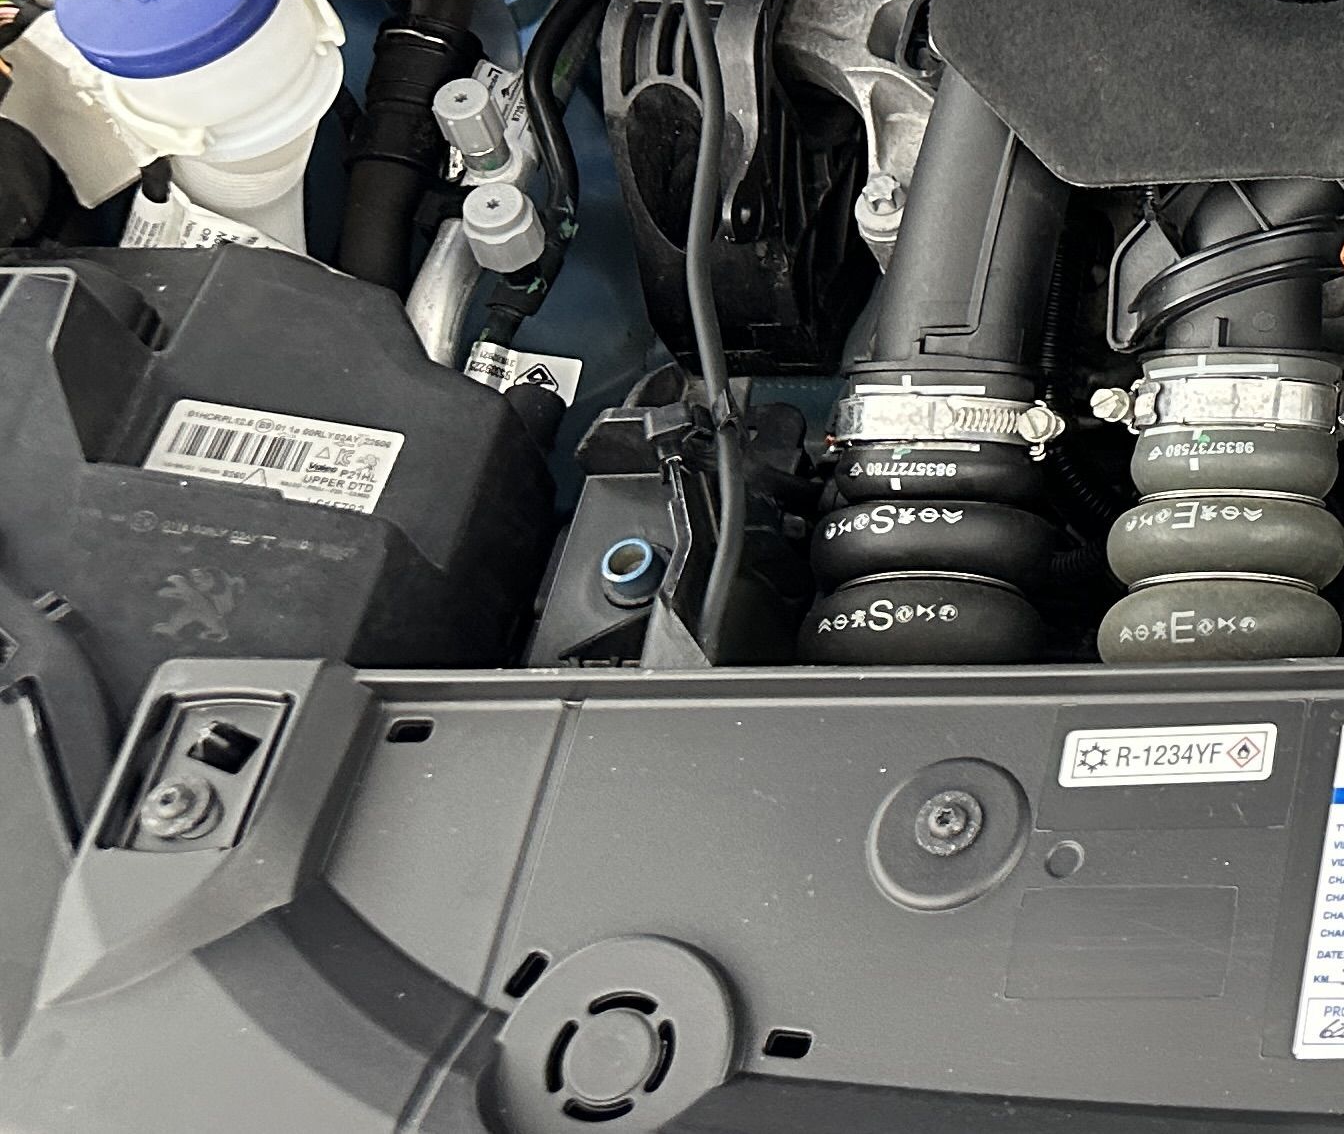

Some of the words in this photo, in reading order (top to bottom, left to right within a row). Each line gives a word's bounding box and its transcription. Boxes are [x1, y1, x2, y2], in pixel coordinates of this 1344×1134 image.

[303, 474, 344, 488] UPPER
[348, 480, 375, 493] DTD
[1171, 502, 1200, 529] E
[868, 599, 895, 632] S
[1170, 611, 1197, 644] E
[1116, 742, 1223, 767] R-1234YF
[1317, 950, 1344, 958] DATE
[1313, 975, 1329, 983] KM
